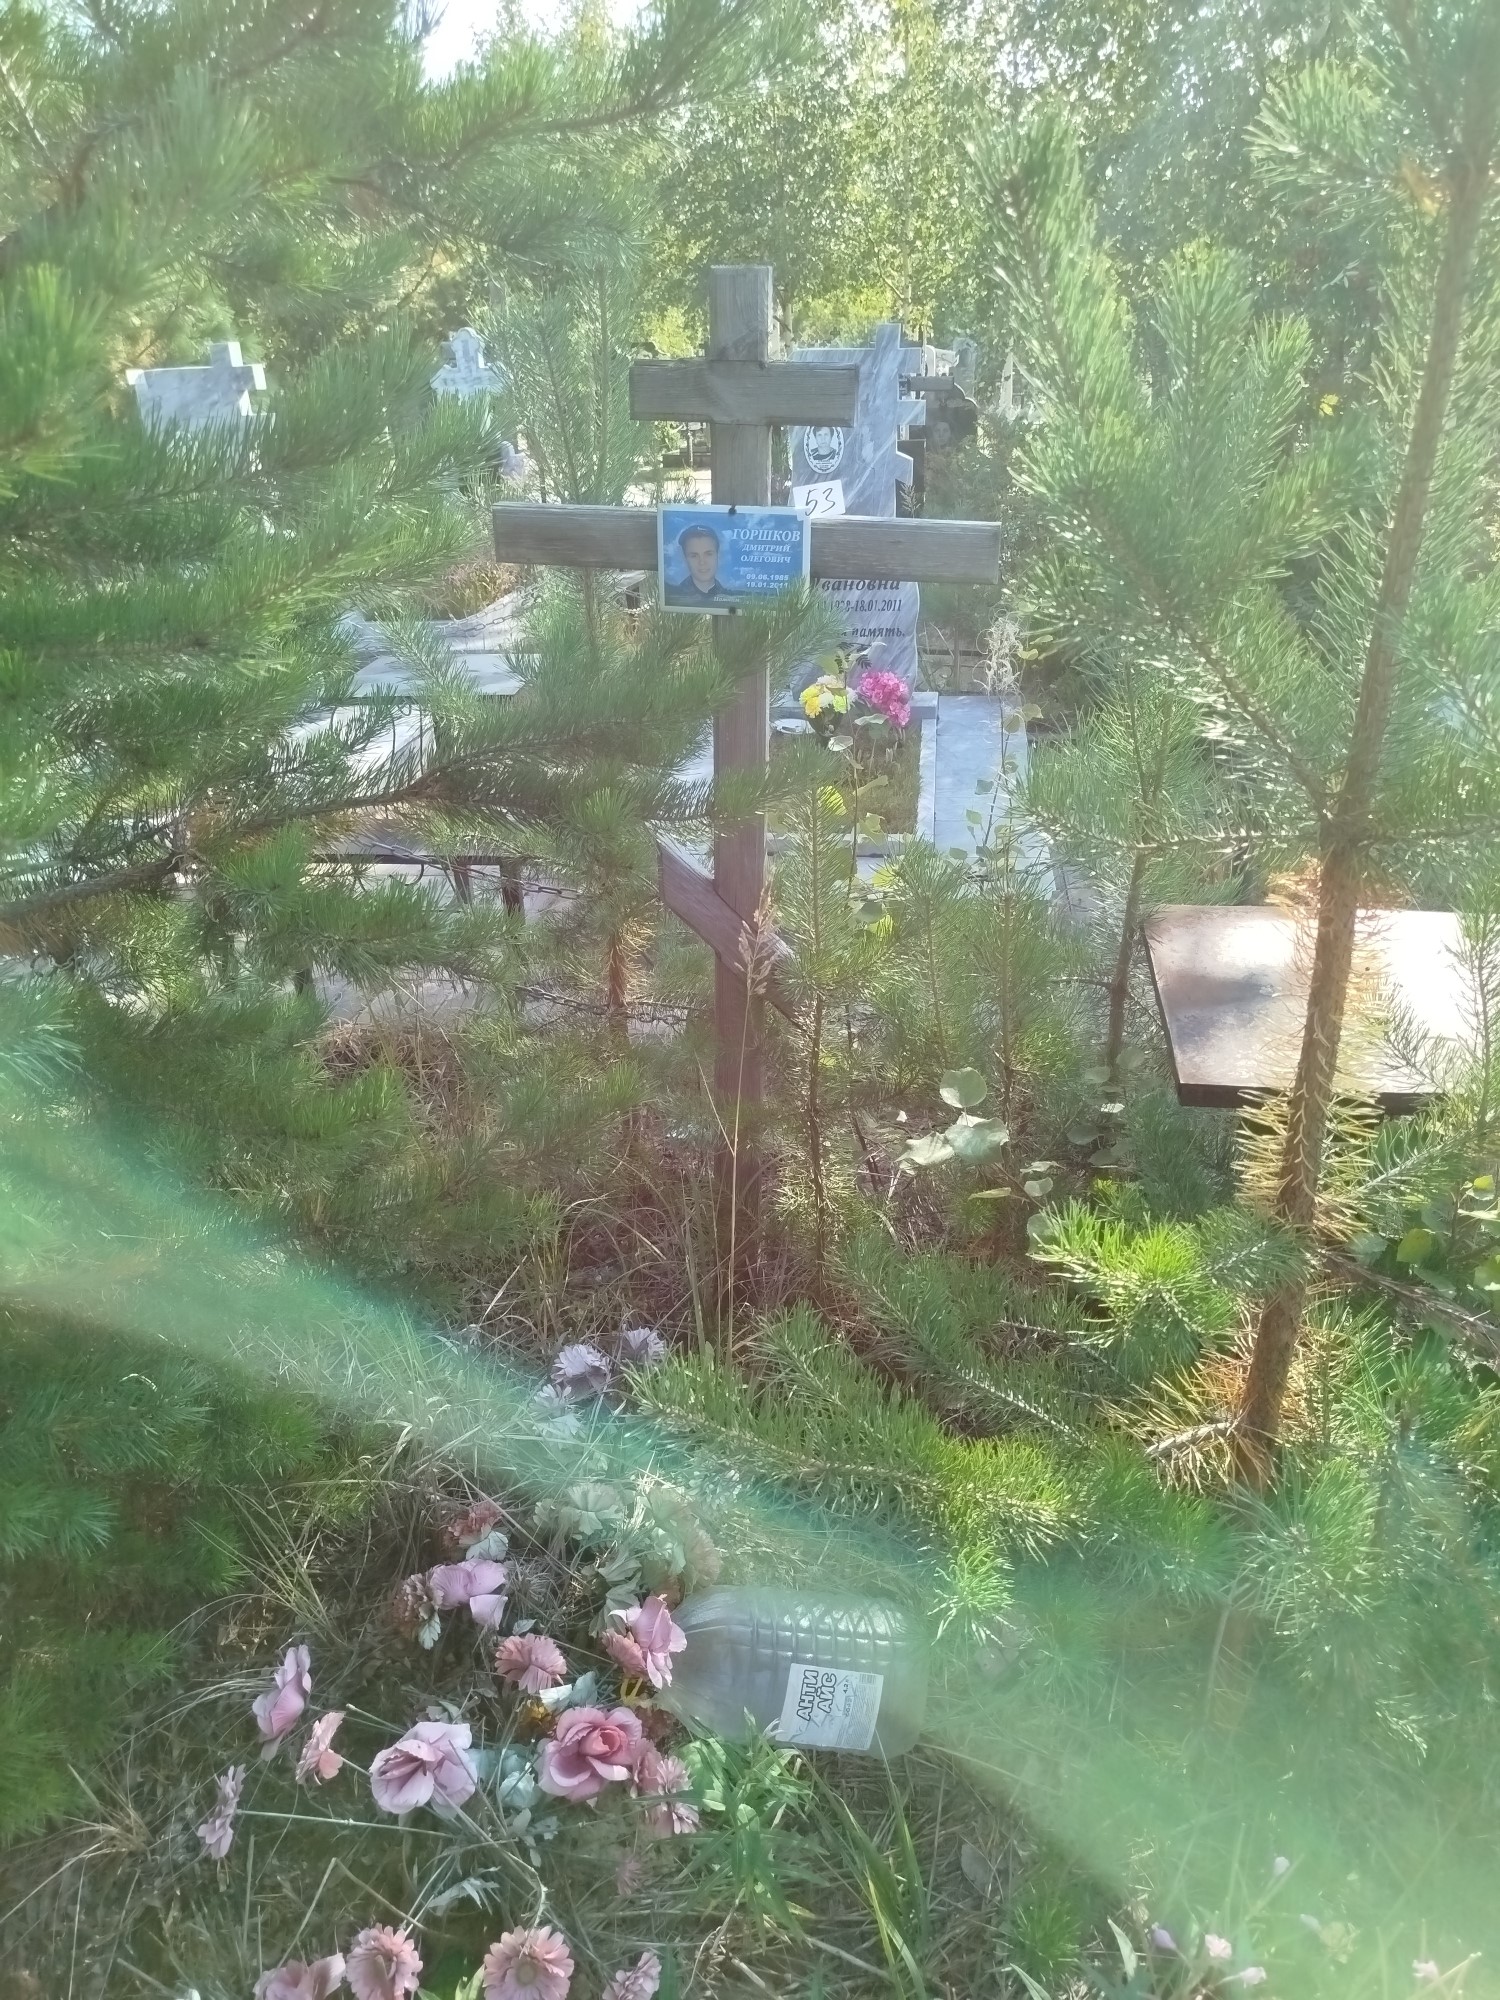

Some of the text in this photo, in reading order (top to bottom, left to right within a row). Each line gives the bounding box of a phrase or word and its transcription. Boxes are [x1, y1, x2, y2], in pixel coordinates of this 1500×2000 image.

[805, 487, 836, 517] 53
[732, 529, 801, 541] ГОРШКОВ
[742, 543, 791, 552] ДМИТРИЙ
[741, 555, 791, 563] ОЛЕГОВИЧ
[814, 579, 900, 591] вановна
[797, 1669, 819, 1722] АНТИ
[817, 1672, 837, 1714] АЙС
